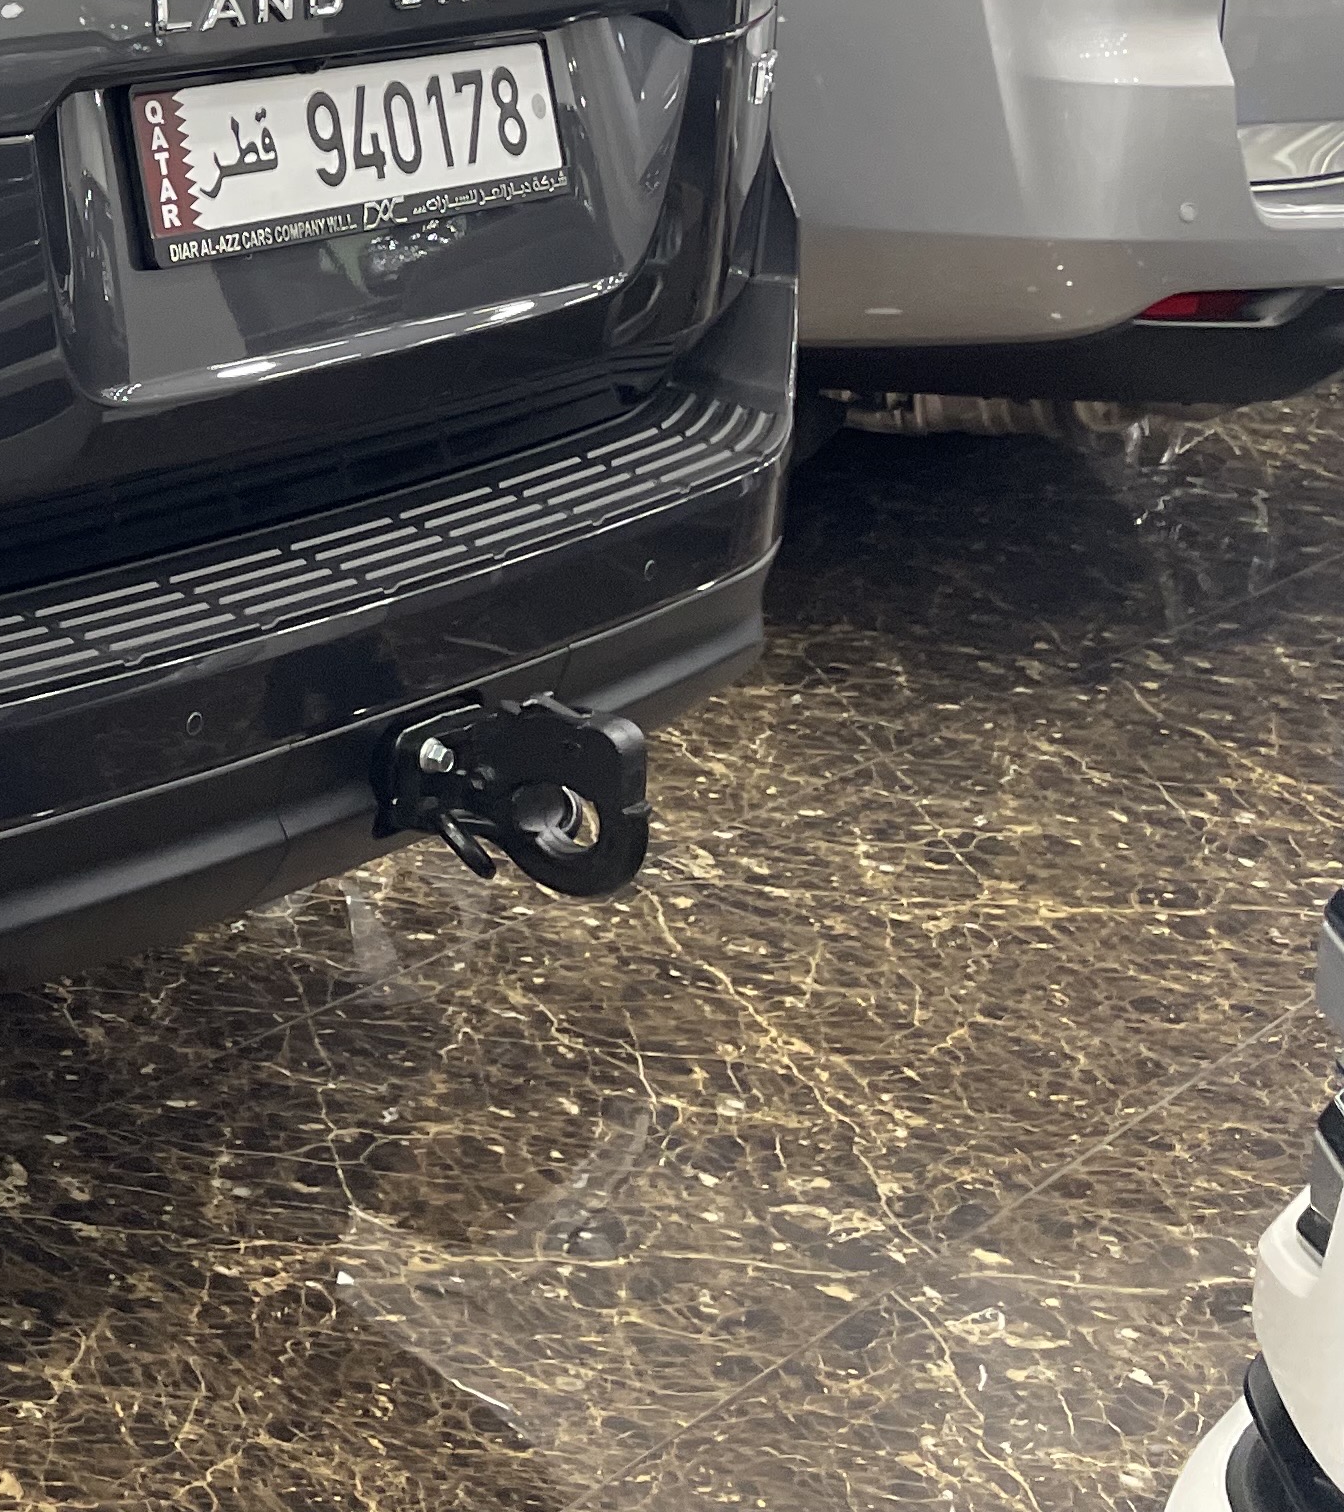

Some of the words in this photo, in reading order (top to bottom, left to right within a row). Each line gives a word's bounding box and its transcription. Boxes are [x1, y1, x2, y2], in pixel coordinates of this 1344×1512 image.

[143, 99, 182, 229] QATAR
[199, 106, 279, 199] قطر
[305, 65, 528, 188] 940178
[532, 171, 568, 193] شركة
[168, 241, 200, 263] DIAR
[241, 228, 274, 249] CARS
[274, 217, 326, 243] COMPANY
